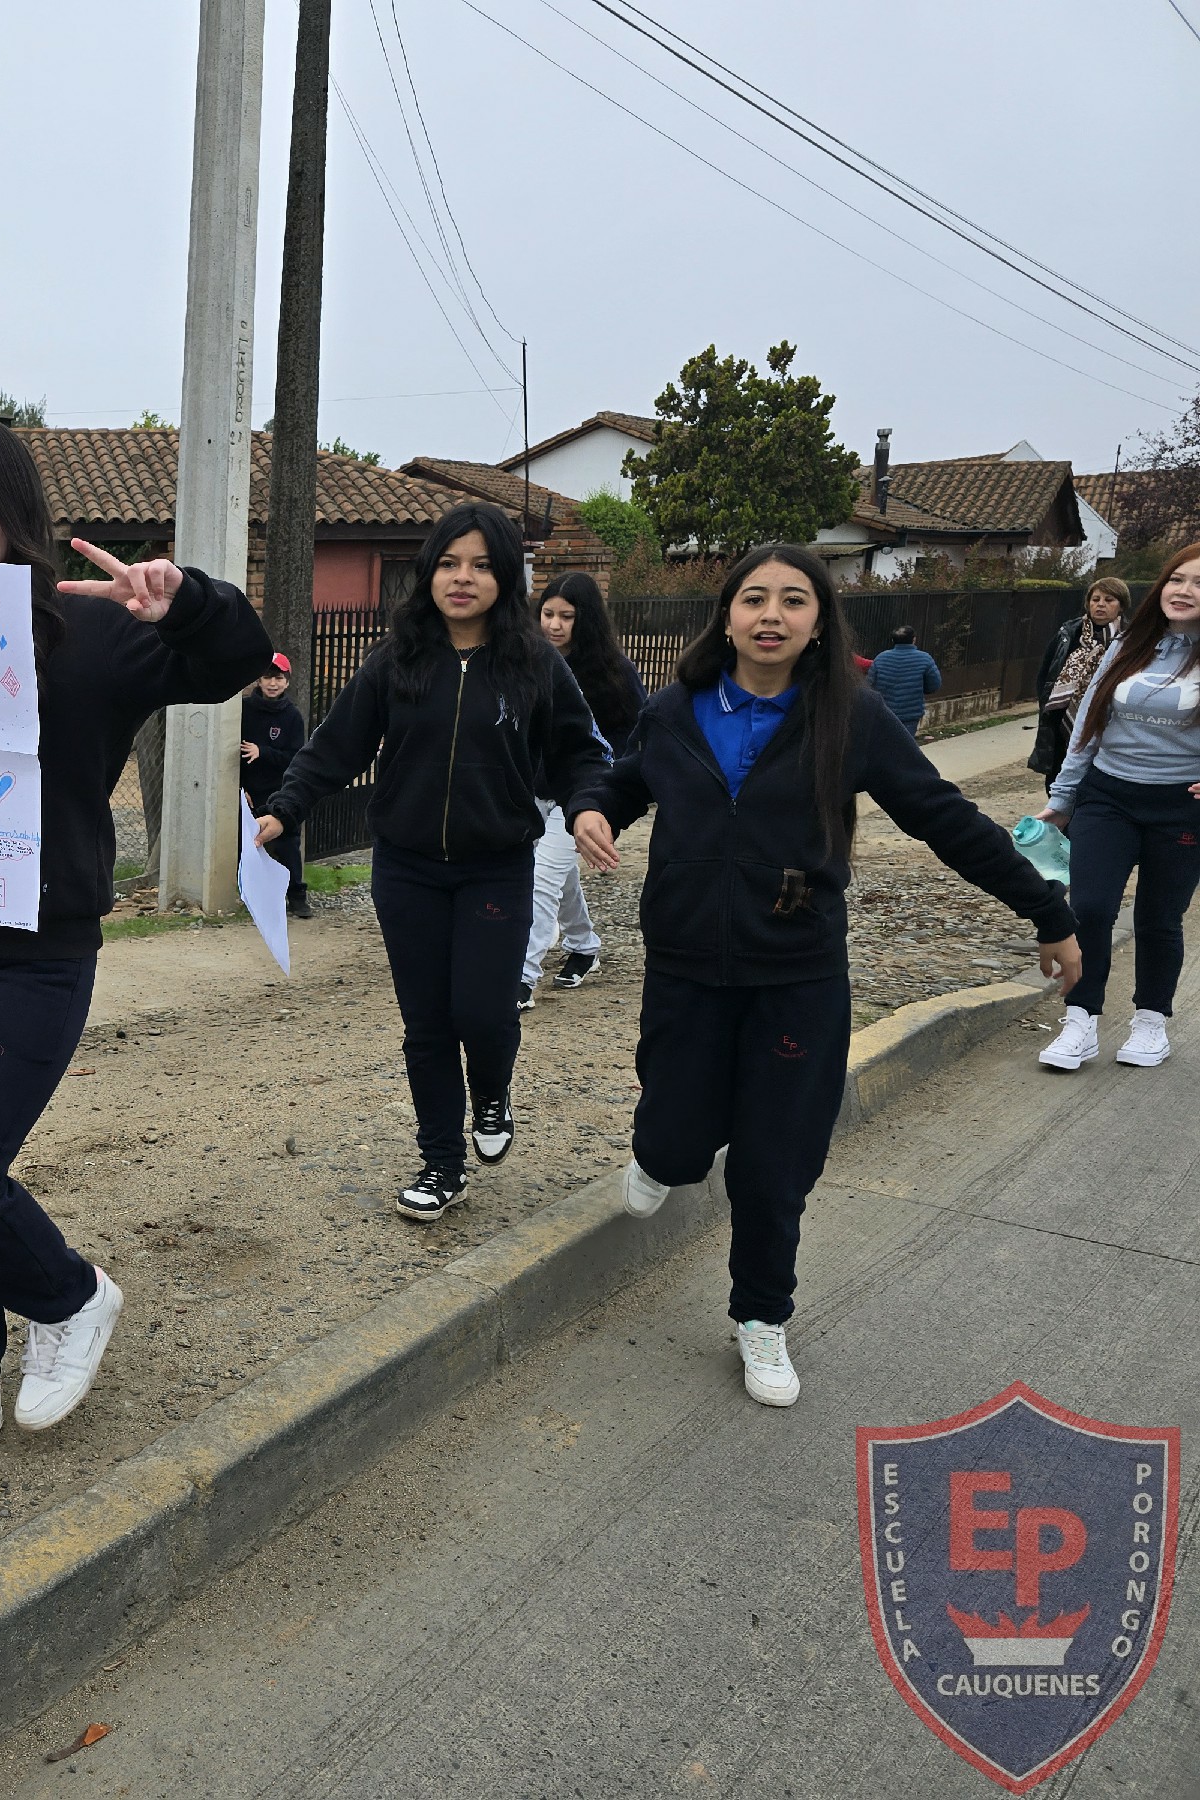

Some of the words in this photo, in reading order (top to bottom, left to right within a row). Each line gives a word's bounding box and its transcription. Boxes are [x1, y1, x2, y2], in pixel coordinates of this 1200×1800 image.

[1117, 711, 1144, 722] DER
[1146, 715, 1193, 726] ARMO
[783, 1035, 798, 1050] EP
